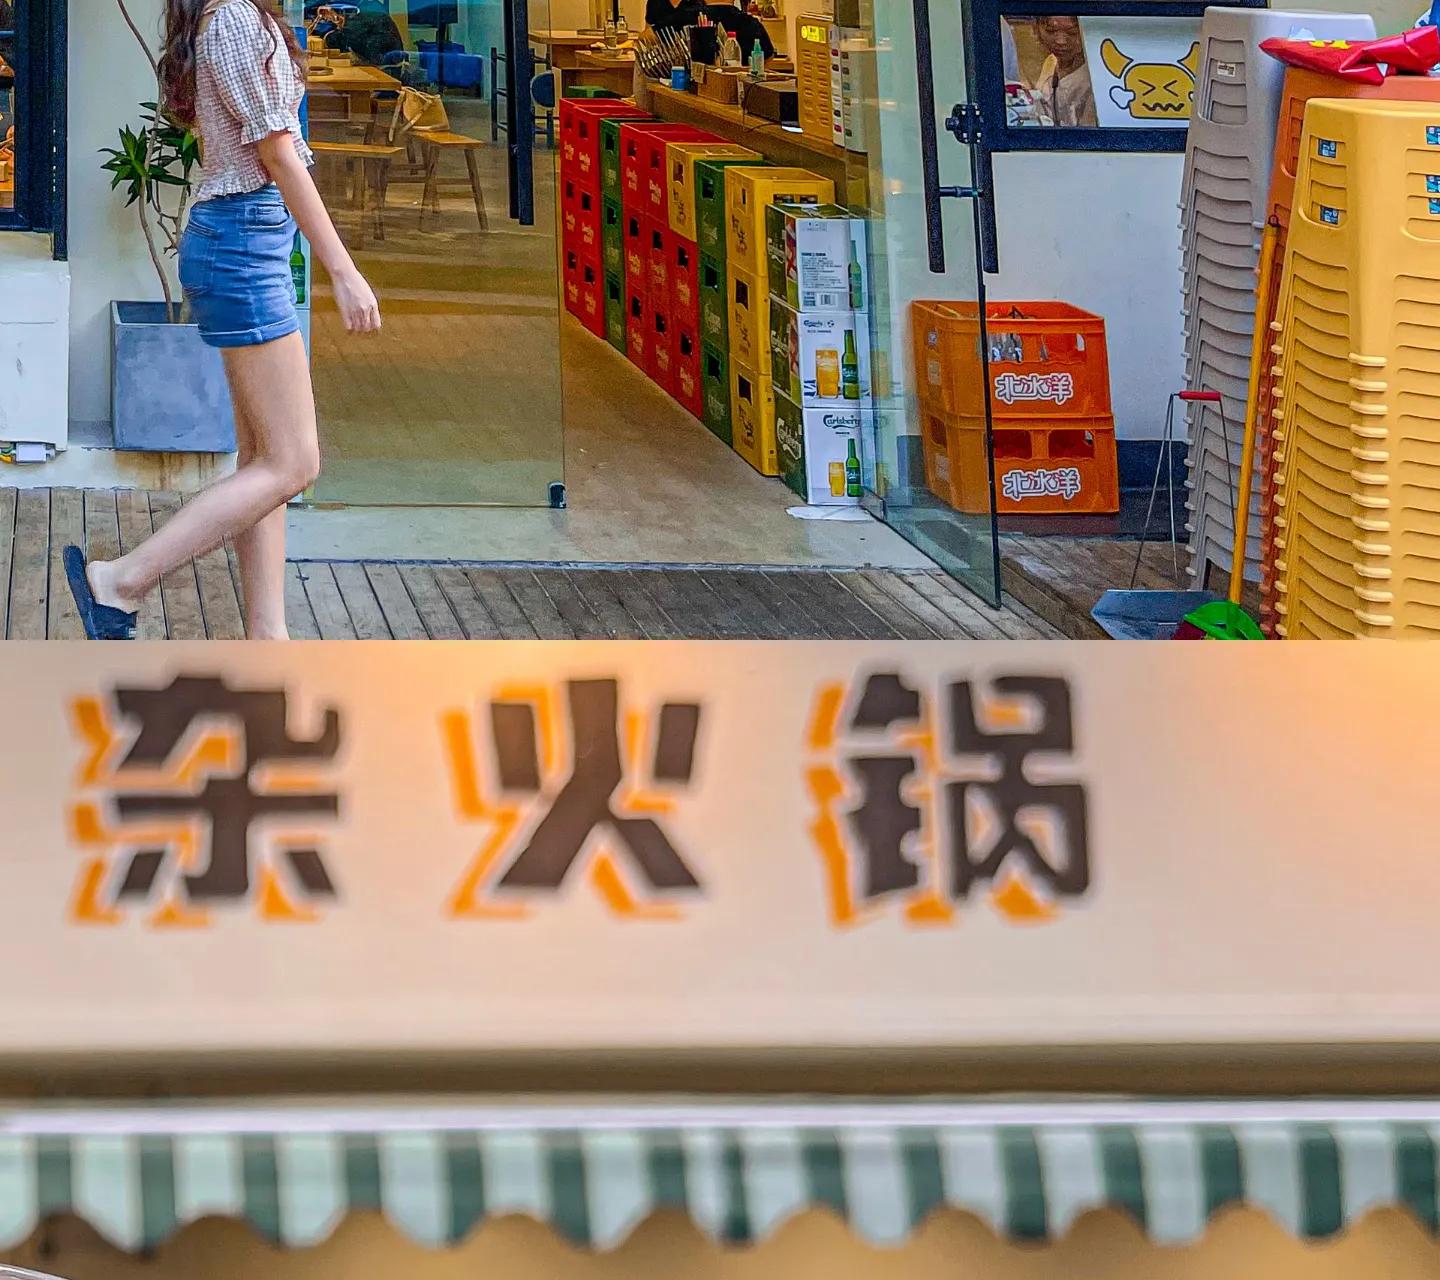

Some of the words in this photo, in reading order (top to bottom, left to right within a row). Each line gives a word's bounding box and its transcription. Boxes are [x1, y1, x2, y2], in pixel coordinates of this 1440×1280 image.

[995, 373, 1074, 405] 北冰洋
[1002, 468, 1081, 500] 北冰洋
